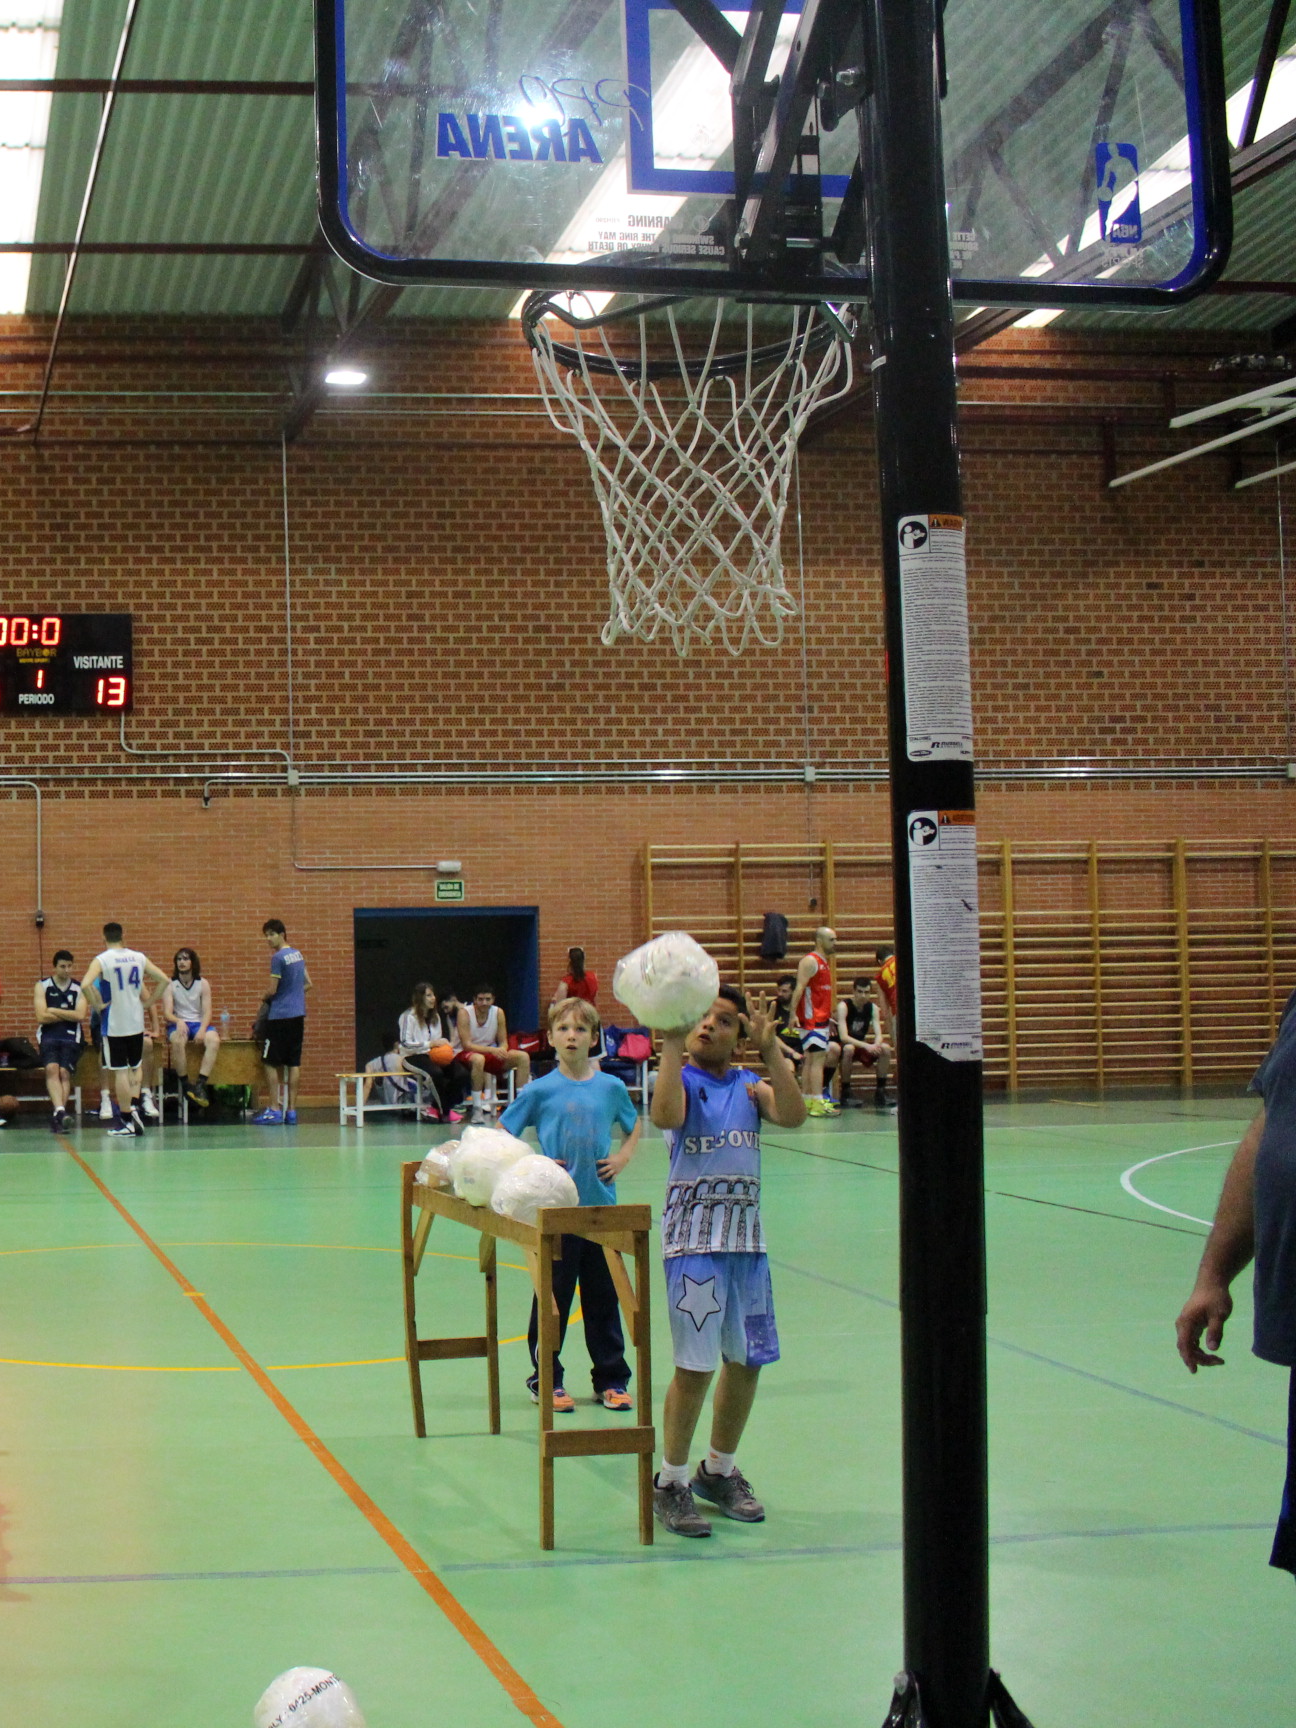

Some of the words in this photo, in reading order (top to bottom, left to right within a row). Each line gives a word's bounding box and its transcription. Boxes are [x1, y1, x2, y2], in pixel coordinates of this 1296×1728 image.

[73, 655, 124, 669] VISITANTE
[36, 669, 44, 688] 1
[18, 693, 54, 704] PERIODO
[97, 677, 126, 706] 13
[114, 966, 140, 990] 14
